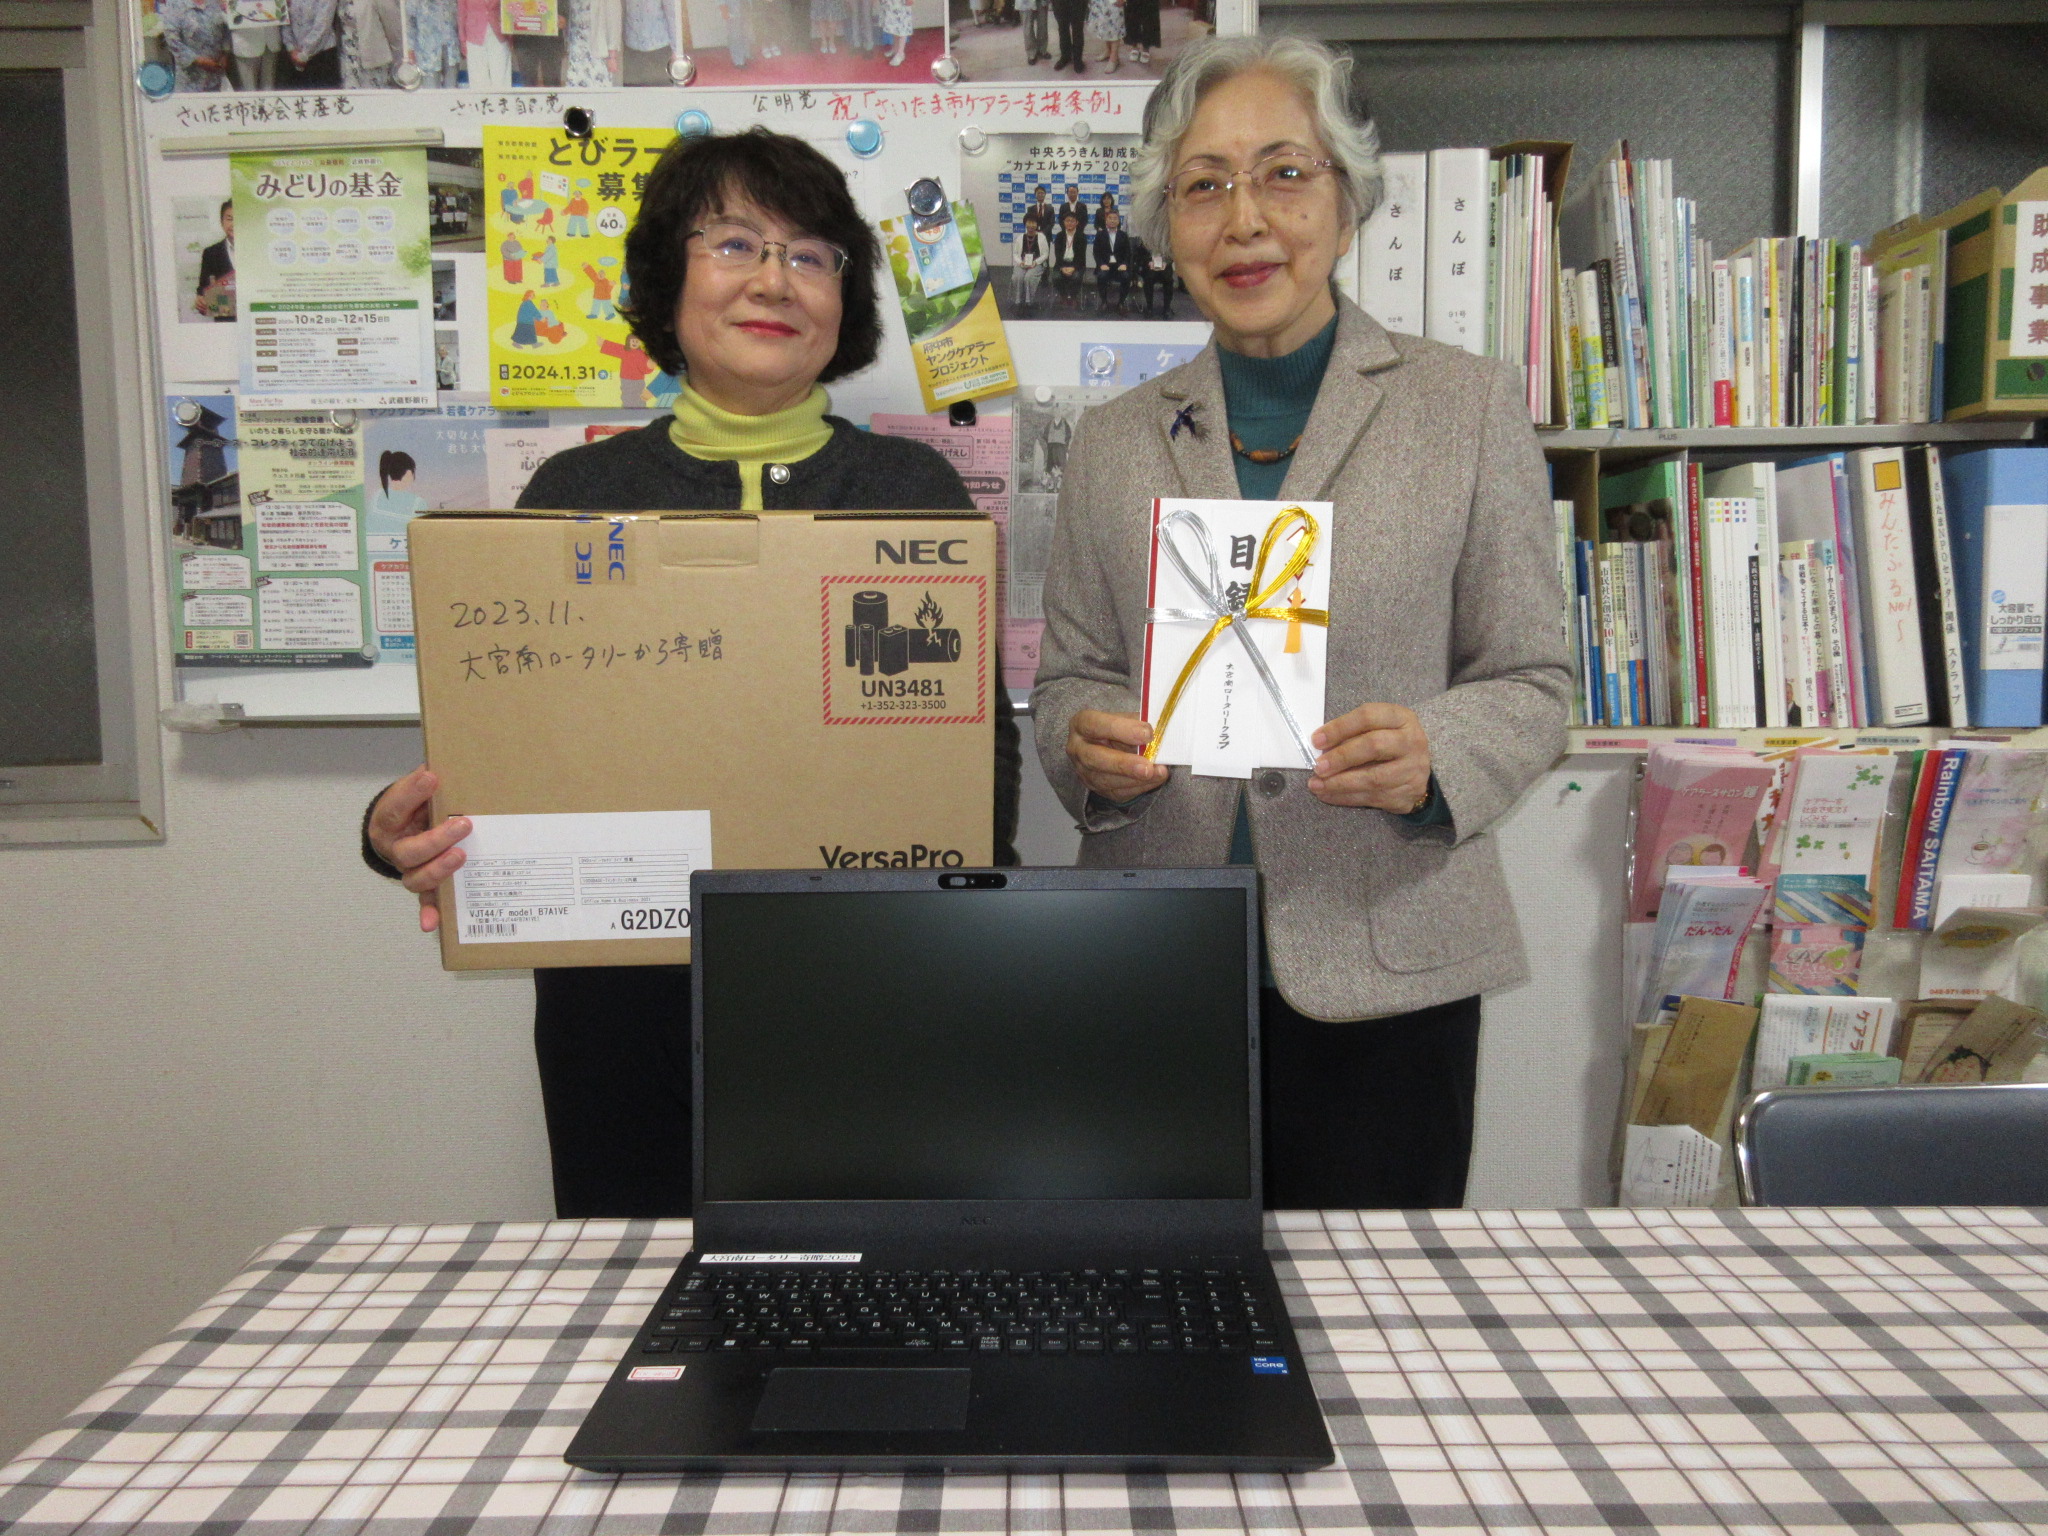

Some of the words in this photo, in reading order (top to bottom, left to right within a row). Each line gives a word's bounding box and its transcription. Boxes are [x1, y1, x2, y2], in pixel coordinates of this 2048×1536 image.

[753, 90, 816, 113] 公明党
[256, 171, 404, 198] みどりの基金
[1389, 204, 1403, 281] さんぽ
[1452, 197, 1466, 276] さんぽ
[923, 337, 953, 354] 府中市
[926, 341, 996, 366] ヤングケアラー
[512, 366, 596, 380] 2024.1.31
[929, 355, 989, 379] プロジェクト
[437, 431, 486, 441] 大切な人
[608, 521, 625, 581] NEC
[875, 539, 968, 565] NEC
[1990, 615, 2042, 626] しっかり自立
[1998, 603, 2035, 614] 大容量で
[460, 628, 723, 681] 大宮南ロータリーから寄贈
[861, 679, 945, 697] UN3481
[1948, 647, 1962, 705] スクラップ
[861, 700, 946, 710] +1-352-323-3500
[1216, 663, 1234, 750] 大宮南ロータリークラブ
[1930, 757, 1960, 833] Rainbow
[819, 844, 964, 869] VersaPro
[1912, 837, 1940, 919] SAITAMA
[469, 908, 503, 918] VJT44/F
[508, 908, 533, 916] model
[538, 906, 569, 915] B7A1VE
[708, 1254, 857, 1262] 大宮南ロータリー寄贈2023
